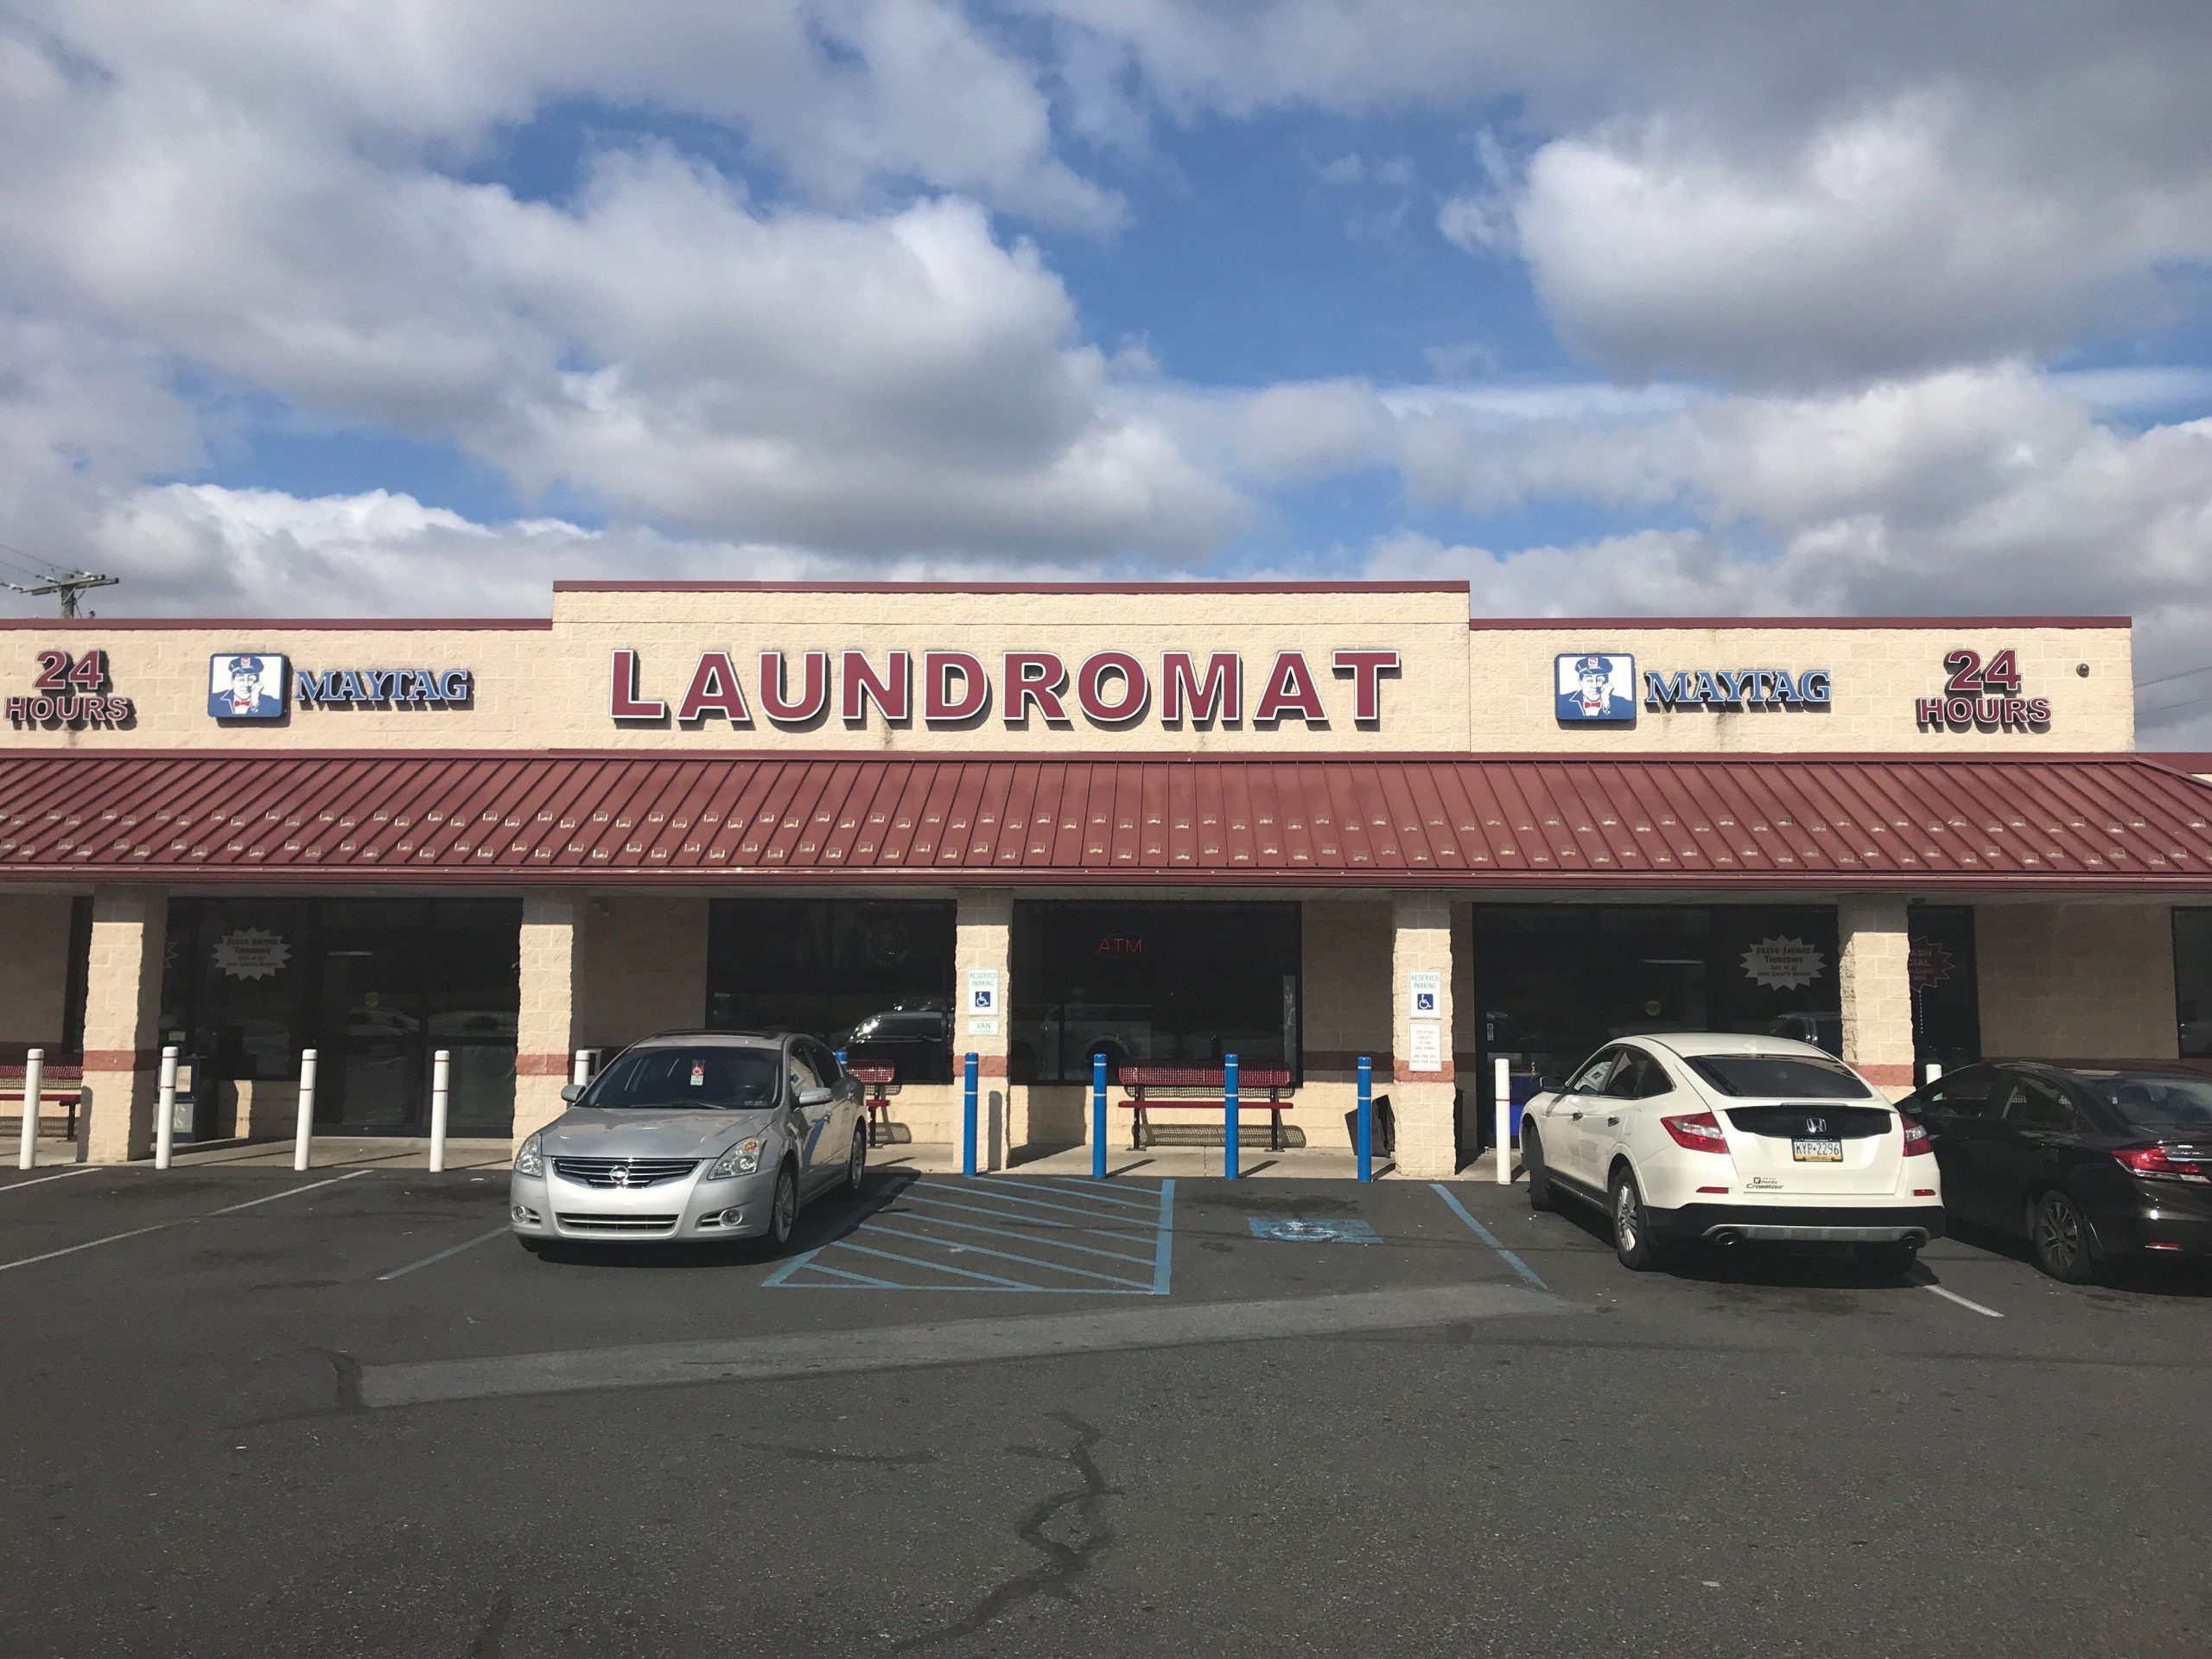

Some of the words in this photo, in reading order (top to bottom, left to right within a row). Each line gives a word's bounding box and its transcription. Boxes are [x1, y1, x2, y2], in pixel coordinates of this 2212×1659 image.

[33, 650, 103, 690] 24
[294, 669, 468, 701] MAYTAG
[1948, 648, 2023, 690] 24
[609, 649, 1401, 722] LAUNDROMAT
[1645, 670, 1832, 702] MAYTAG
[4, 696, 129, 721] HOURS
[1920, 697, 2053, 722] HOURS
[1097, 938, 1142, 954] ATM
